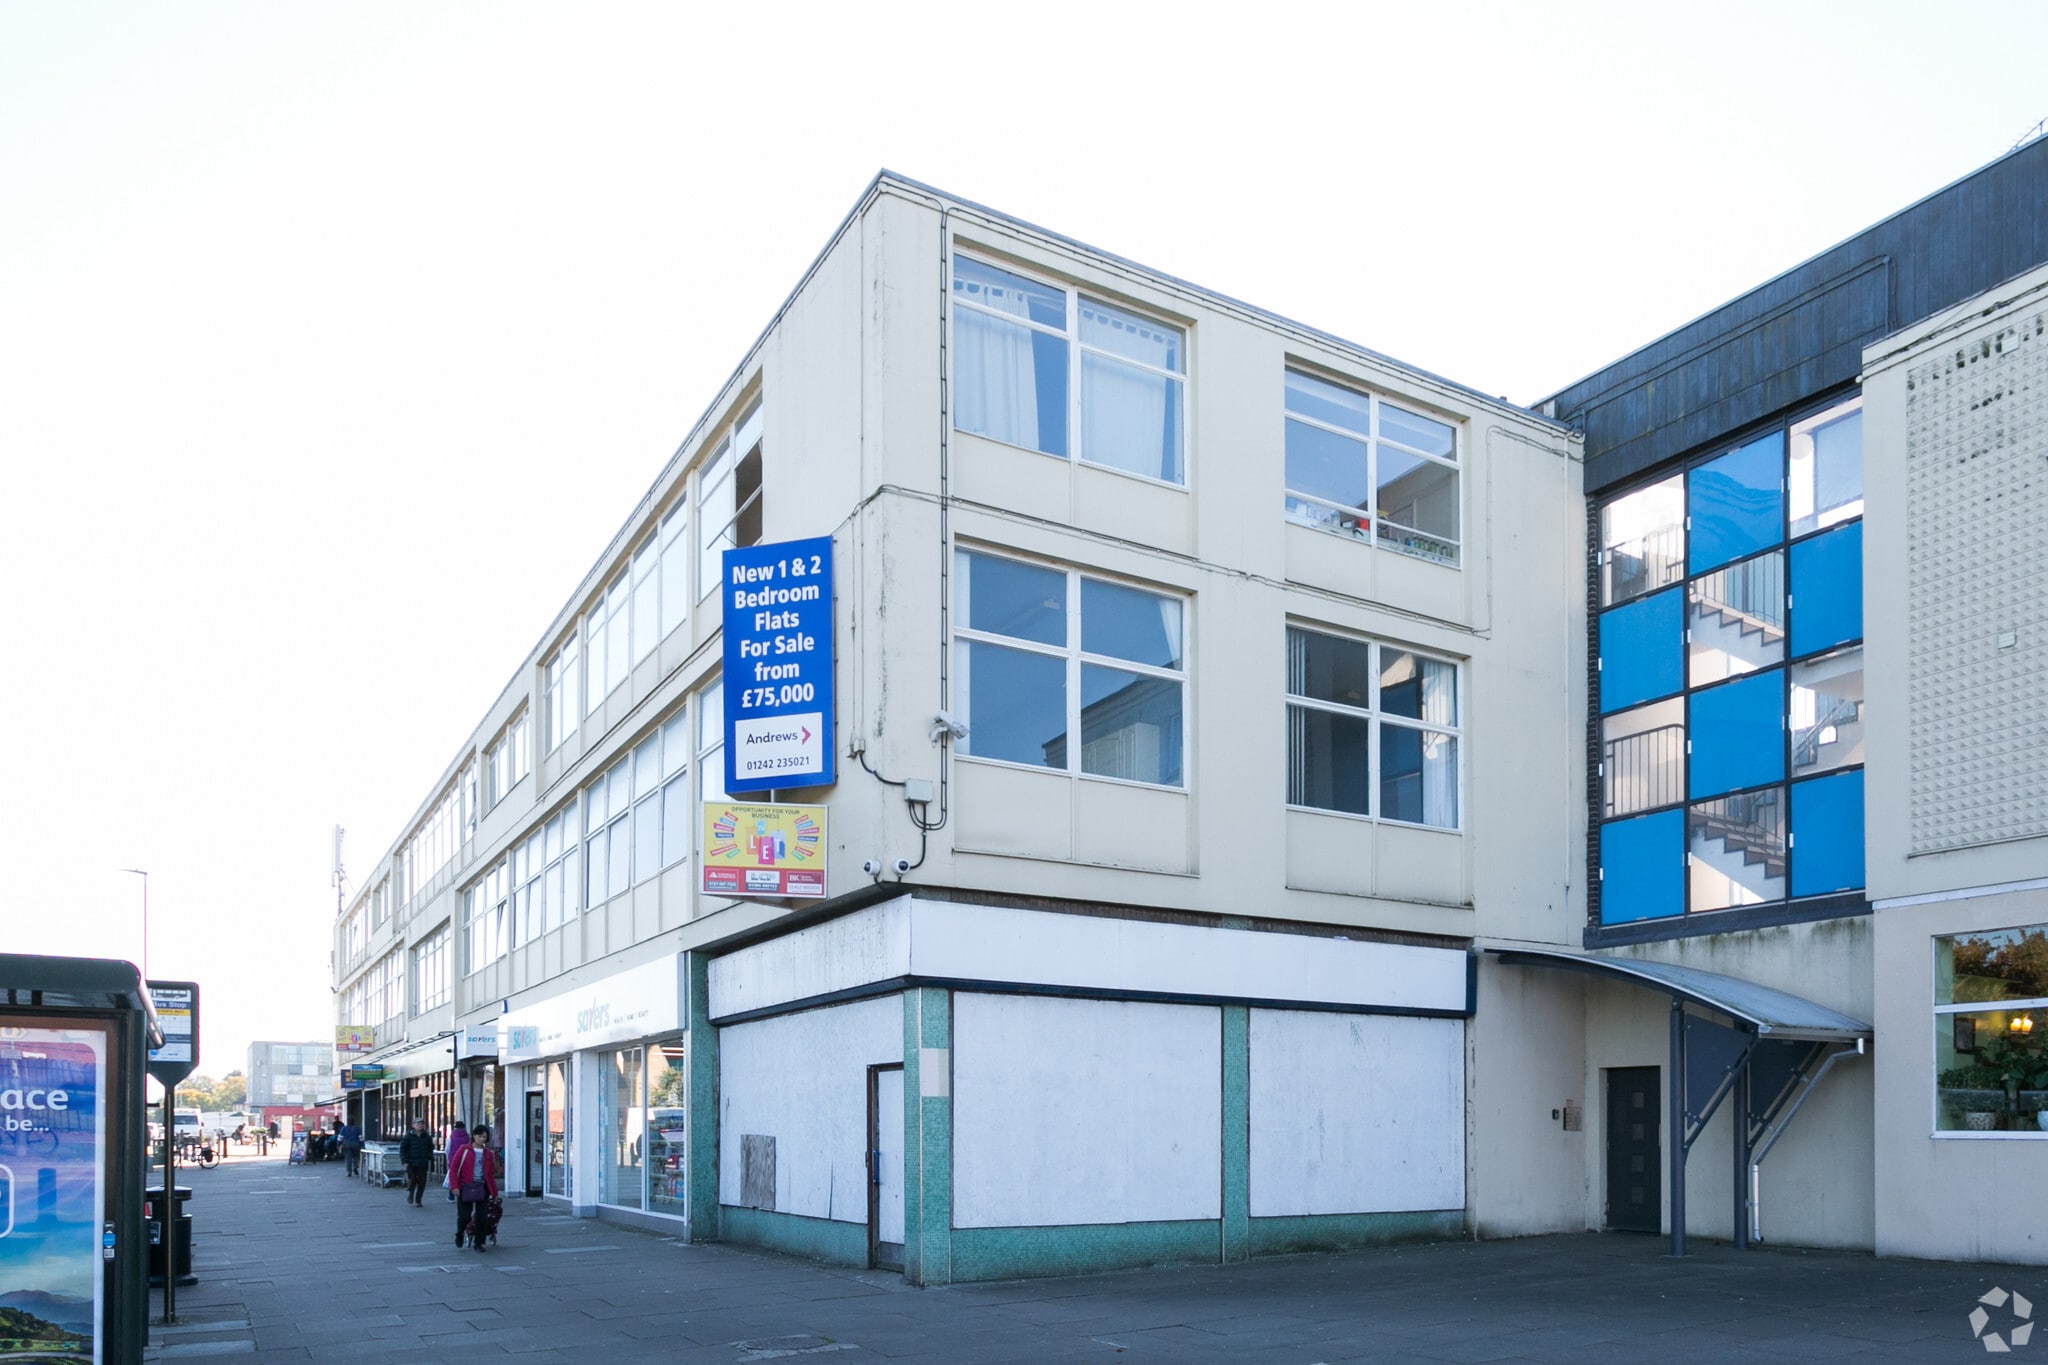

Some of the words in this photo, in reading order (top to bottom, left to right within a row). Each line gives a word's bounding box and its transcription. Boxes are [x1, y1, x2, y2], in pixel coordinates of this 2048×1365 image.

[733, 565, 774, 584] New
[778, 560, 786, 578] 1
[791, 557, 806, 576] &
[810, 555, 821, 574] 2
[735, 585, 819, 609] Bedroom
[755, 611, 800, 631] Flats
[741, 639, 771, 658] For
[775, 632, 815, 654] Sale
[754, 661, 800, 681] from
[742, 682, 814, 708] £75,000
[746, 732, 798, 744] Andrews
[747, 760, 773, 770] 01242
[777, 756, 809, 768] 235021
